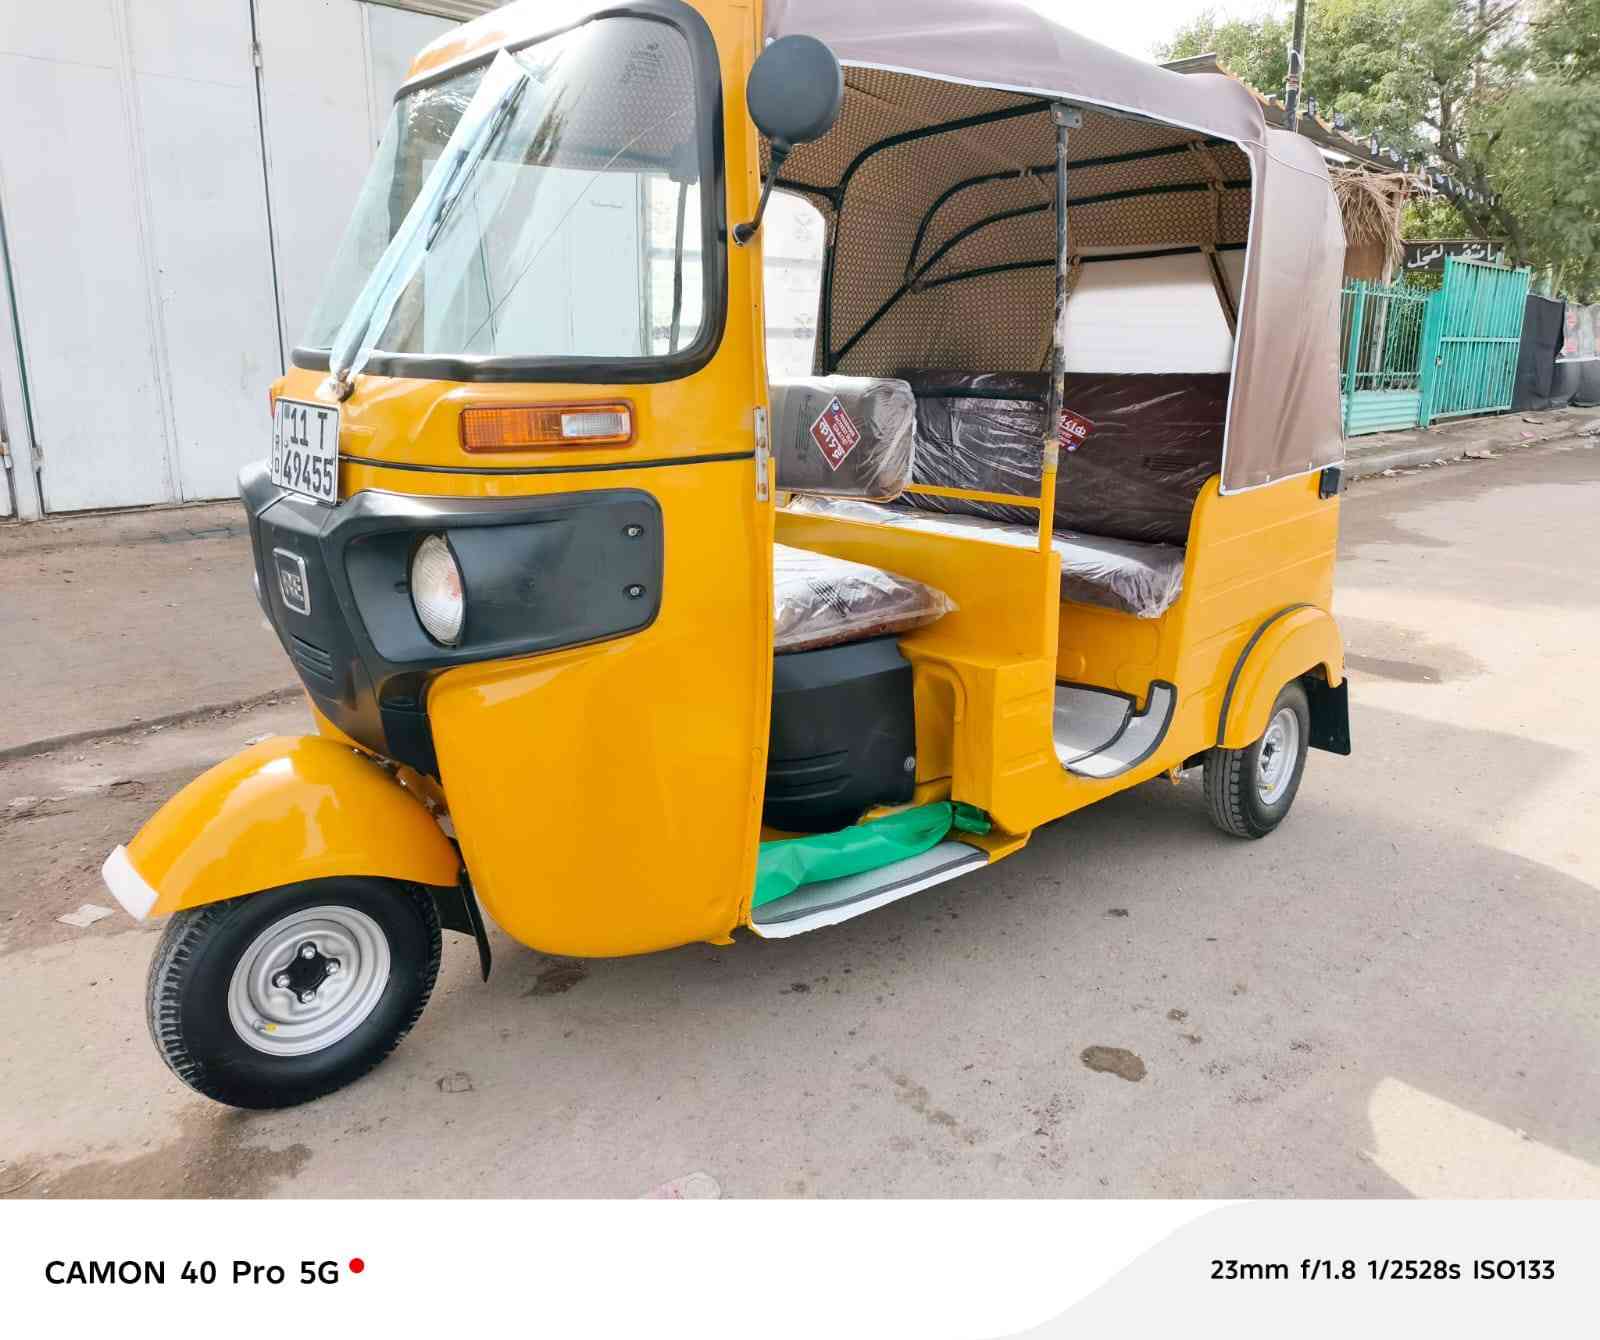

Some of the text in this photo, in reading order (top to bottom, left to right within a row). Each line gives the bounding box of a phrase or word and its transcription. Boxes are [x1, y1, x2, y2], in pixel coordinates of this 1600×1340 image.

[290, 407, 328, 450] 11 T
[283, 449, 334, 496] 49455
